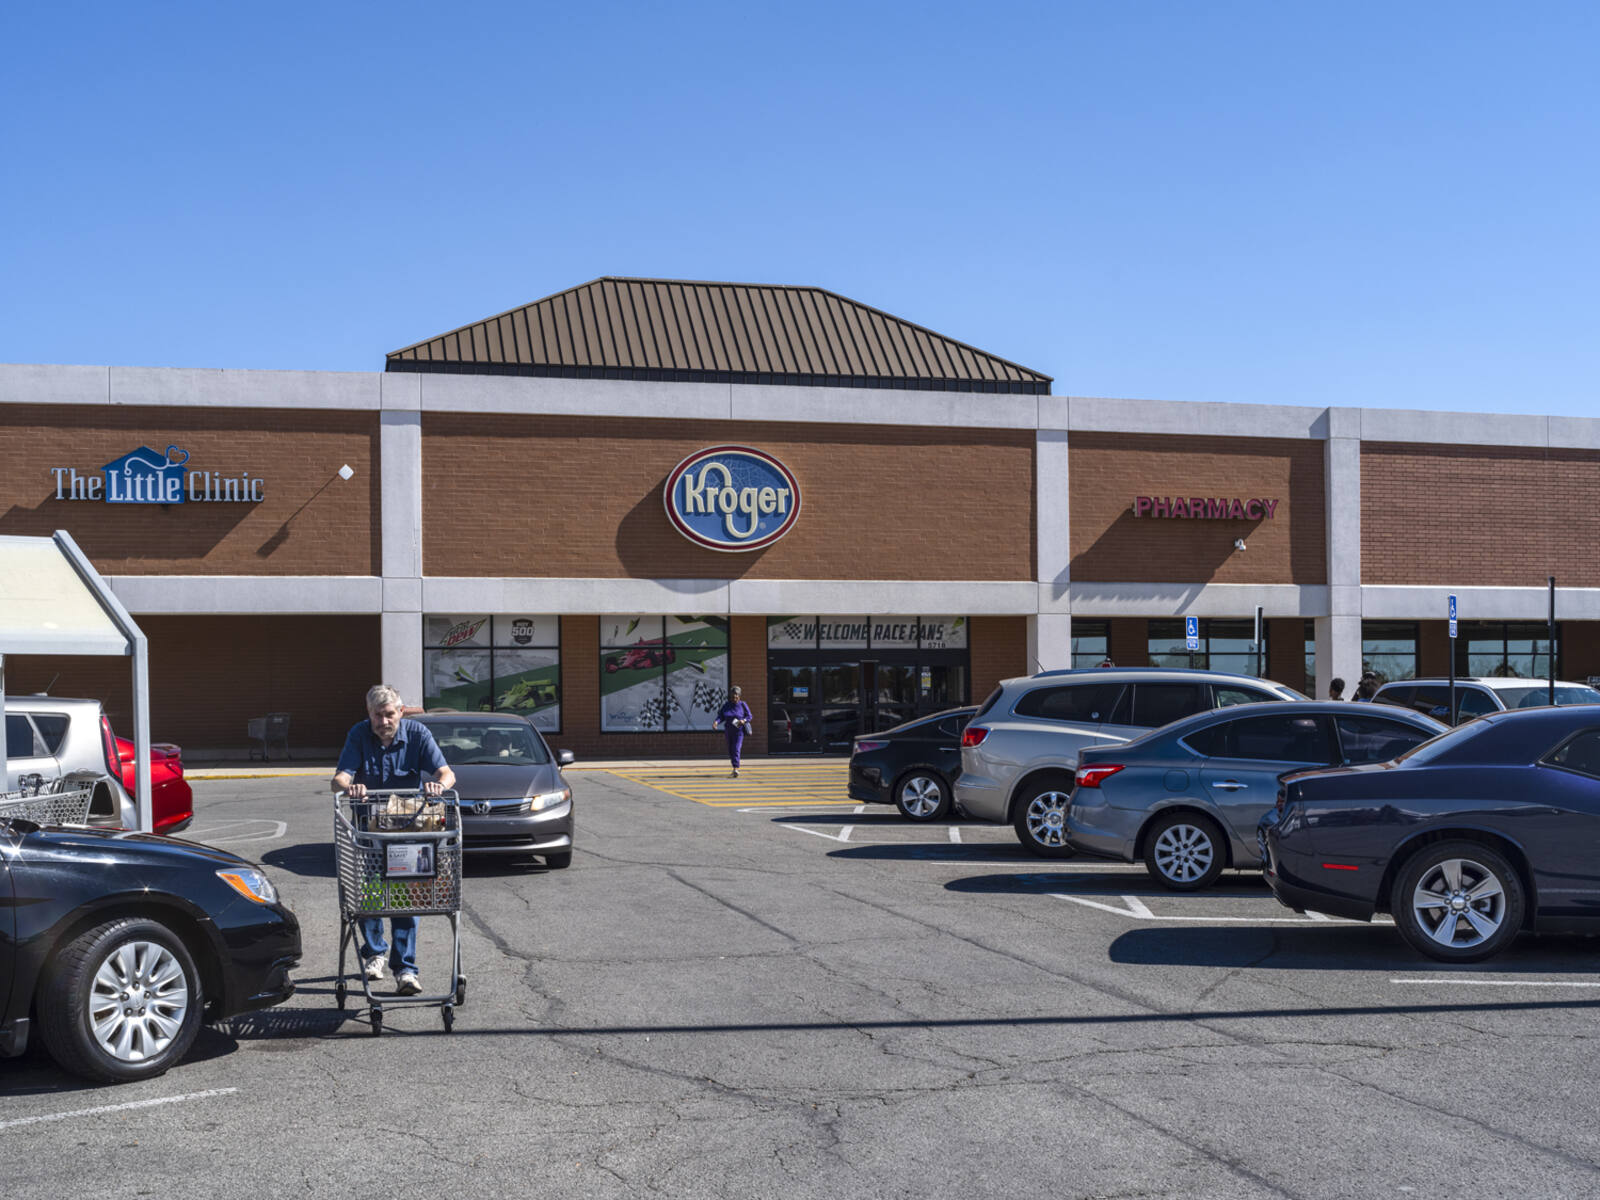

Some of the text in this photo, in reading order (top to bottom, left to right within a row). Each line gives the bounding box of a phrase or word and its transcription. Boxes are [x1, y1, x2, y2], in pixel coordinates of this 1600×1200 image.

[51, 467, 264, 502] The Little Clinic
[685, 462, 789, 539] Kroger
[1134, 496, 1279, 520] PHARMACY
[512, 626, 534, 637] 500
[804, 623, 944, 641] WELCOME RACE FANS
